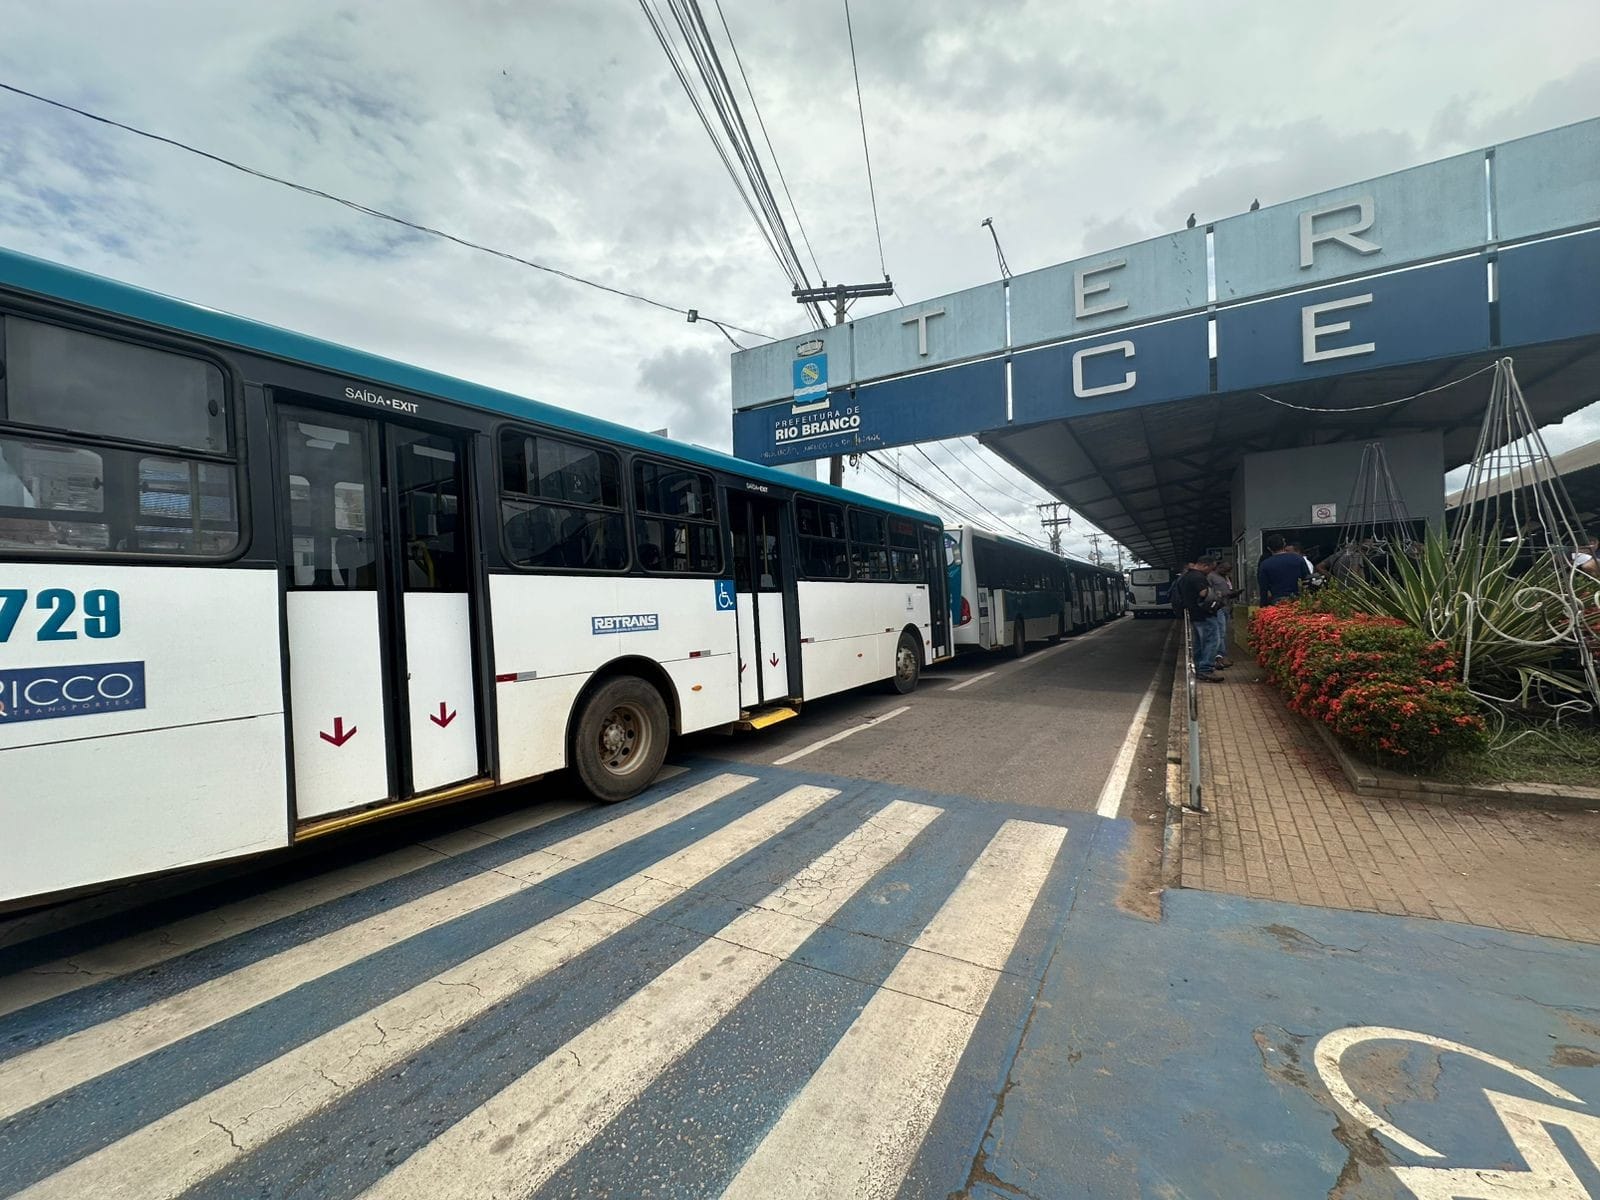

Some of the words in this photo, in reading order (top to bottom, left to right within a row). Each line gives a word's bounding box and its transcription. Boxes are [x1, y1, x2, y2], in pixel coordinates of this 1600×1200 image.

[775, 409, 841, 428] PREFEITURA
[846, 406, 860, 415] DE
[775, 427, 798, 441] RIO
[802, 415, 860, 437] BRANCO
[594, 615, 657, 630] RBTRANS
